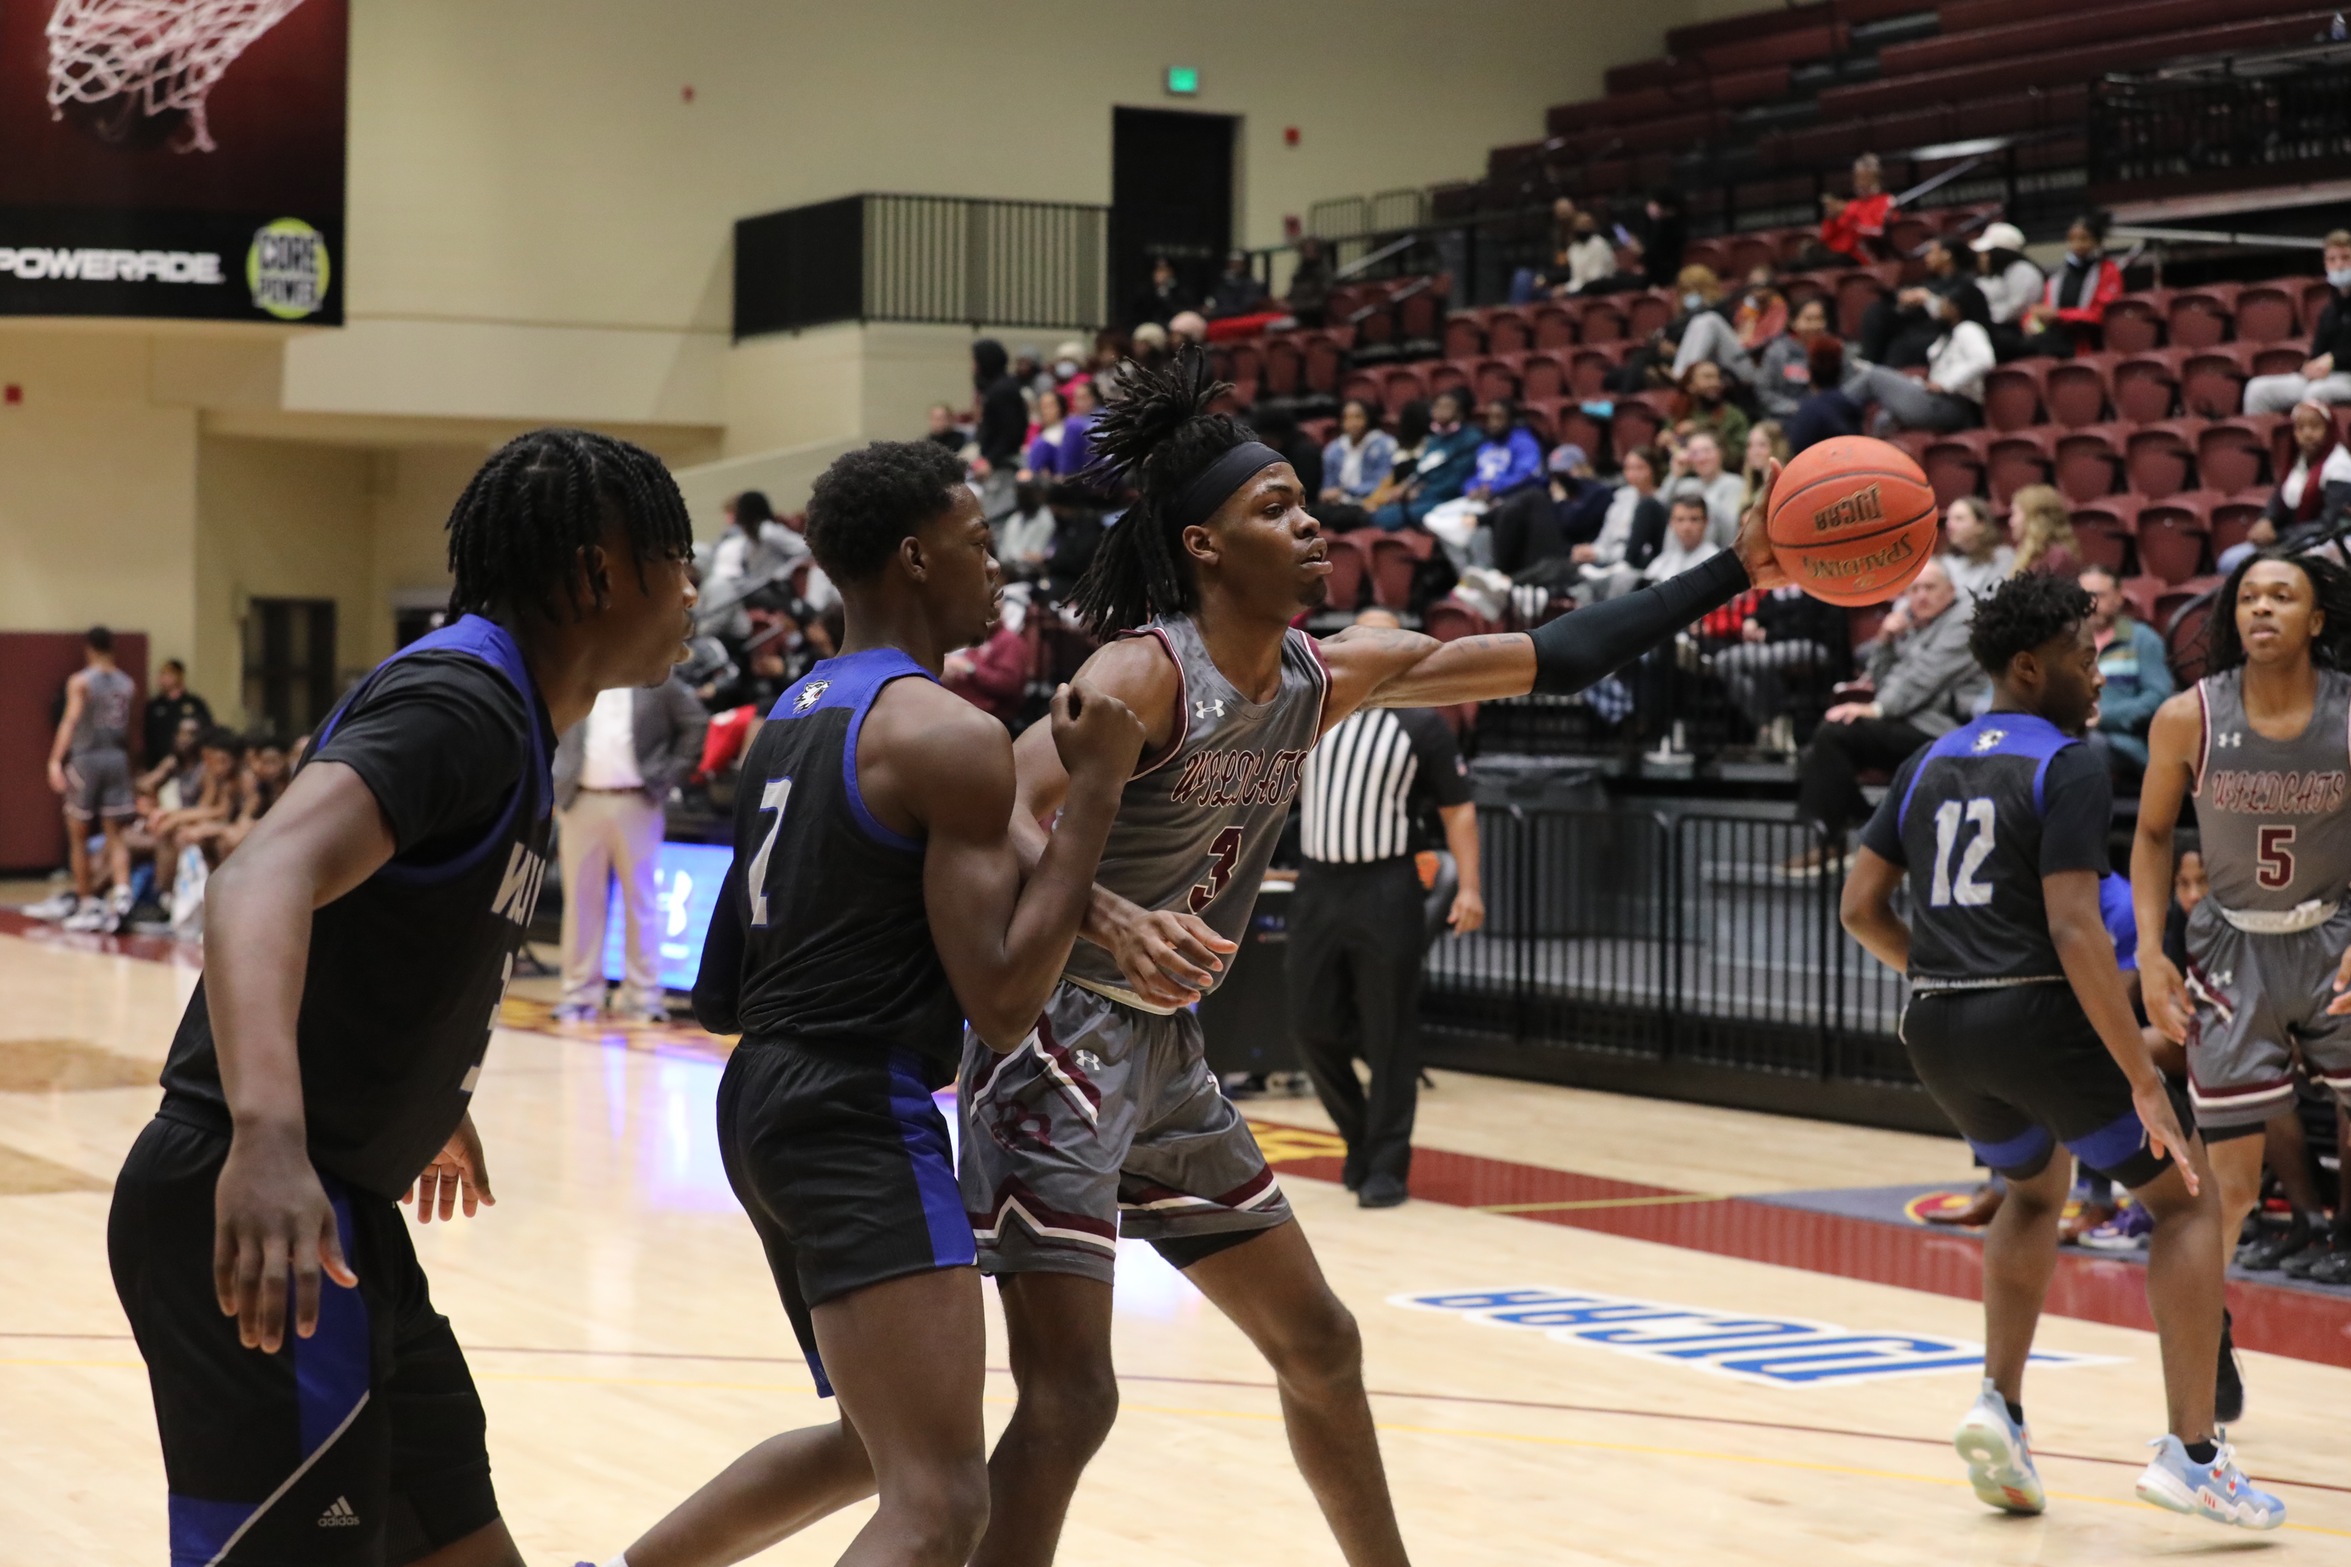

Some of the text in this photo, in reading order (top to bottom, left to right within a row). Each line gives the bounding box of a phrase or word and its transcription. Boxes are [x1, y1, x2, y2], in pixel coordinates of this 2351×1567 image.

[256, 232, 318, 273] CORE
[257, 276, 318, 307] POWER
[1802, 532, 1914, 579] SPALDING
[2211, 769, 2346, 815] WILDCATS
[1187, 826, 1245, 916] 3
[1930, 797, 1996, 907] 12
[2256, 825, 2297, 892] 5
[317, 1515, 361, 1527] adidas
